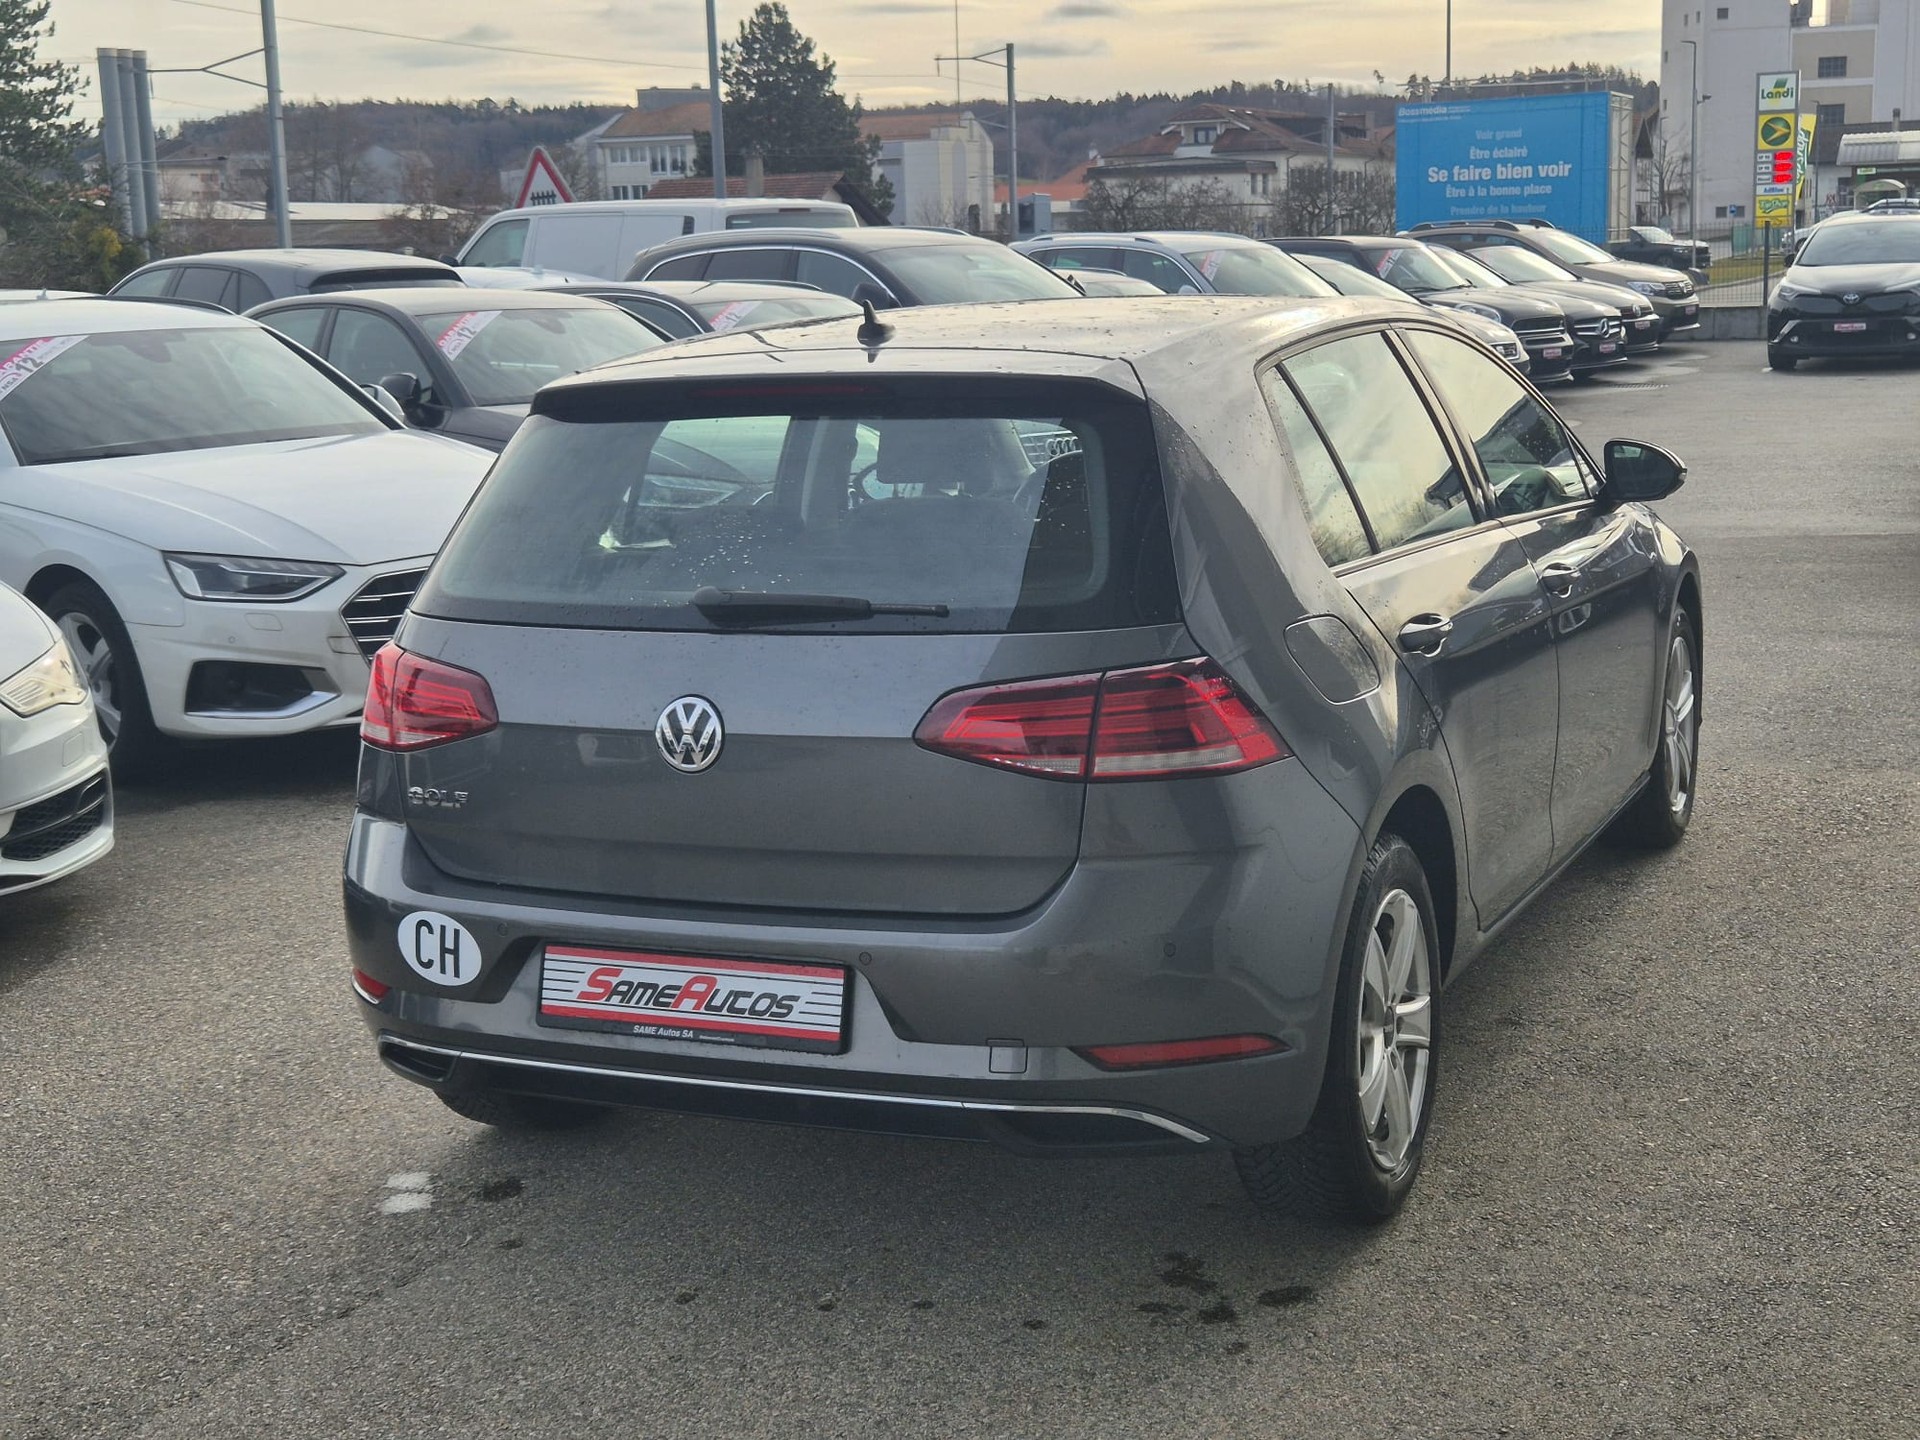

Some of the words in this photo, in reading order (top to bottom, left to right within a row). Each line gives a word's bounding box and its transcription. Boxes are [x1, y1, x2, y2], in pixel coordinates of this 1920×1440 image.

[1760, 87, 1794, 100] Landi
[1475, 130, 1493, 140] Voir
[1495, 128, 1522, 141] grand
[1469, 146, 1490, 160] Être
[1492, 145, 1528, 158] éclairé
[1428, 166, 1448, 183] Se
[1453, 164, 1491, 182] faire
[1496, 163, 1533, 180] bien
[1538, 161, 1572, 178] voir
[1446, 184, 1466, 198] Être
[1468, 184, 1475, 197] à
[1478, 184, 1487, 197] la
[1489, 184, 1521, 197] bonne
[1523, 183, 1552, 198] place
[1487, 204, 1498, 215] de
[1500, 204, 1509, 214] la
[457, 327, 477, 340] 12
[15, 357, 44, 373] 12
[408, 786, 469, 808] GOLF
[414, 918, 461, 979] CH
[633, 1024, 657, 1035] SAME
[657, 1026, 681, 1038] Autos
[681, 1029, 694, 1039] SA
